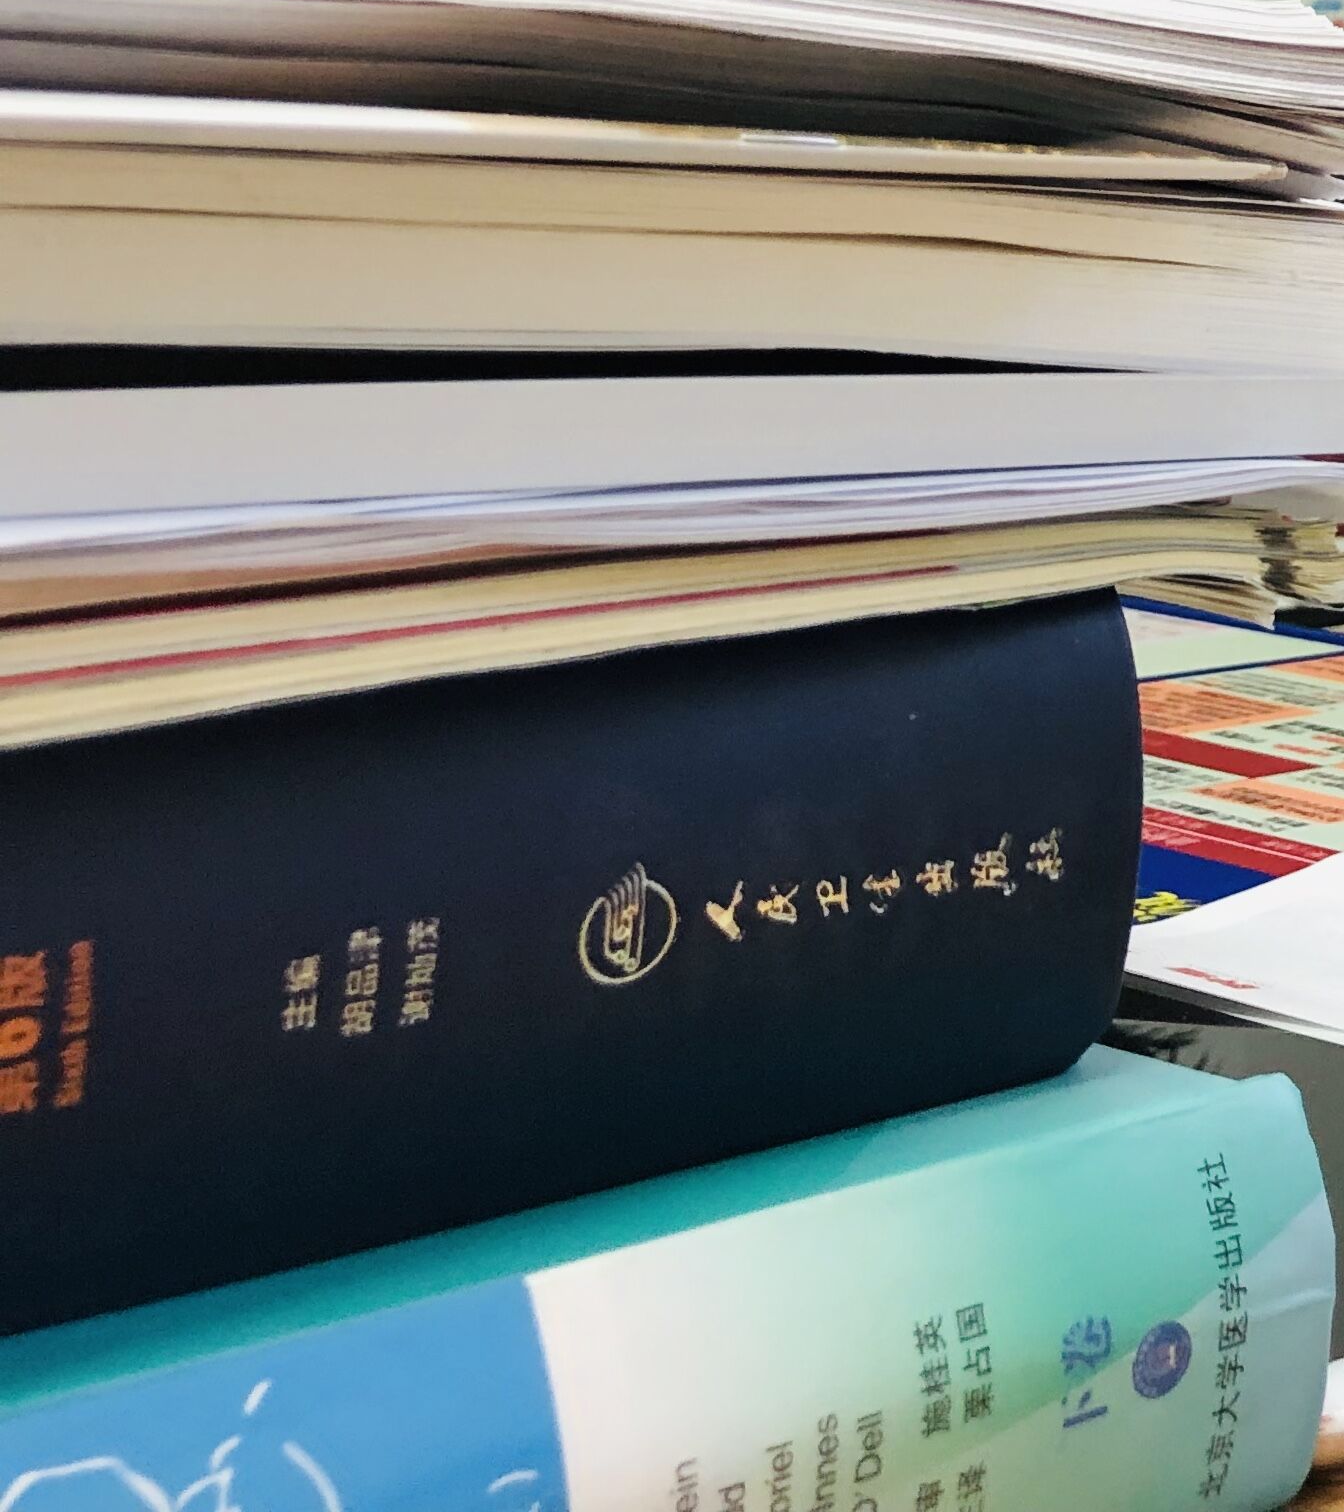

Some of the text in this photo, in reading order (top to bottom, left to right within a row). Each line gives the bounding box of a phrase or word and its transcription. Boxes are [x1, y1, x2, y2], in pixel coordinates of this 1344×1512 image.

[705, 826, 1064, 943] 人民卫生出版社
[281, 953, 322, 1032] 主编
[340, 925, 384, 1038] 胡品津
[912, 1312, 951, 1439] 施桂英
[1196, 1150, 1249, 1500] 北京大学医学出版社
